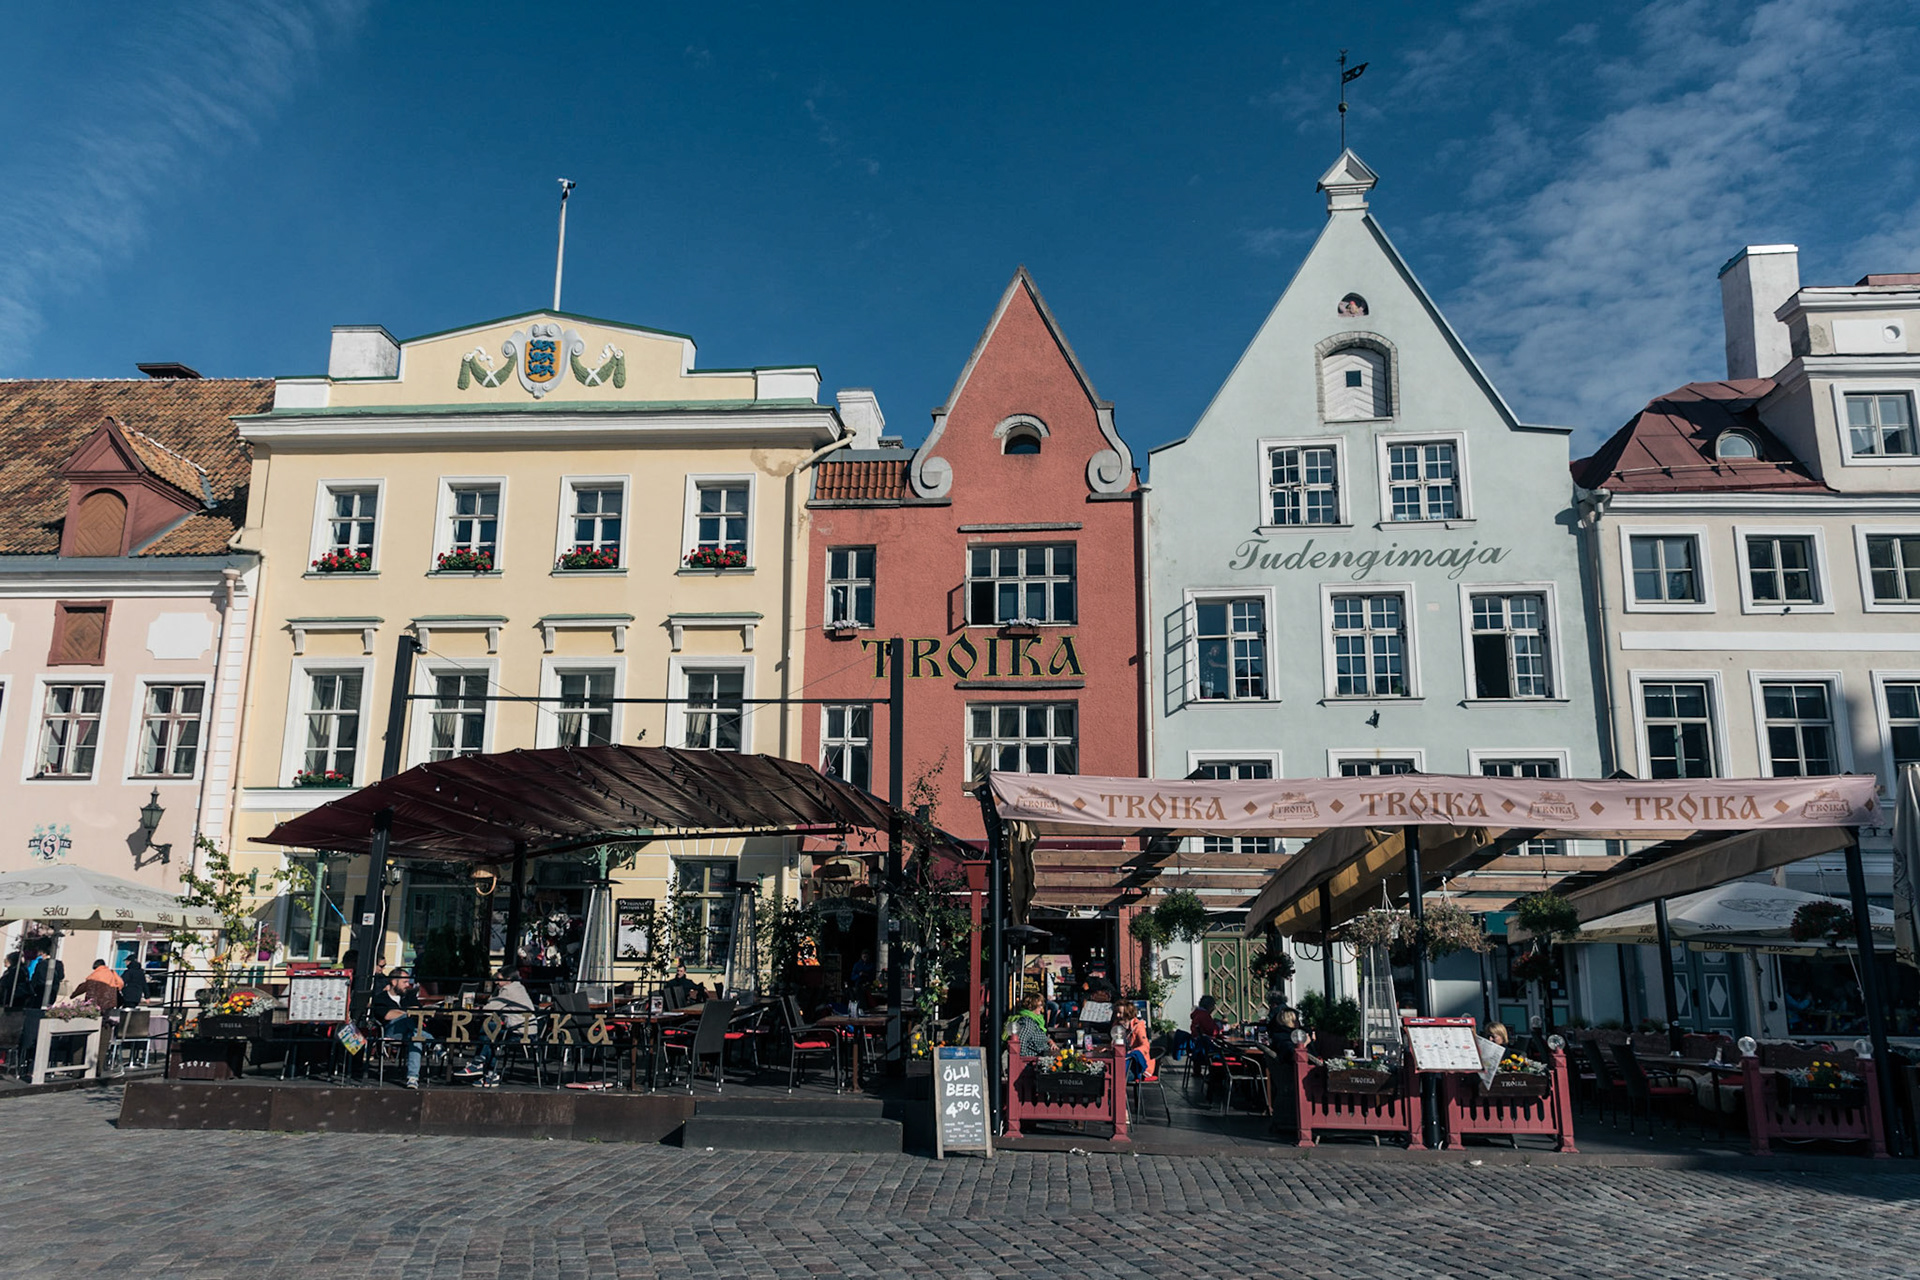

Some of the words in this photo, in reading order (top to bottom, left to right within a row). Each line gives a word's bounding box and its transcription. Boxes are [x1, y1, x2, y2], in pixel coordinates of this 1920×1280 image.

[1229, 539, 1511, 580] Tudengimaja
[861, 632, 1087, 680] TROIKA
[1100, 792, 1227, 822] TROIKA
[1276, 805, 1312, 814] TROIKA
[1359, 788, 1490, 817] TROIKA
[1626, 793, 1764, 823] TROIKA
[1808, 804, 1846, 812] TROIKA
[1535, 805, 1572, 815] TROIKA
[42, 905, 69, 916] saku
[115, 908, 134, 918] saku
[157, 913, 174, 922] saku
[195, 917, 212, 925] saku
[407, 1009, 614, 1045] TROIKA
[943, 1065, 970, 1082] ÕLU
[1501, 1078, 1527, 1087] TROIKA
[946, 1083, 980, 1098] BEER
[971, 1102, 980, 1116] €
